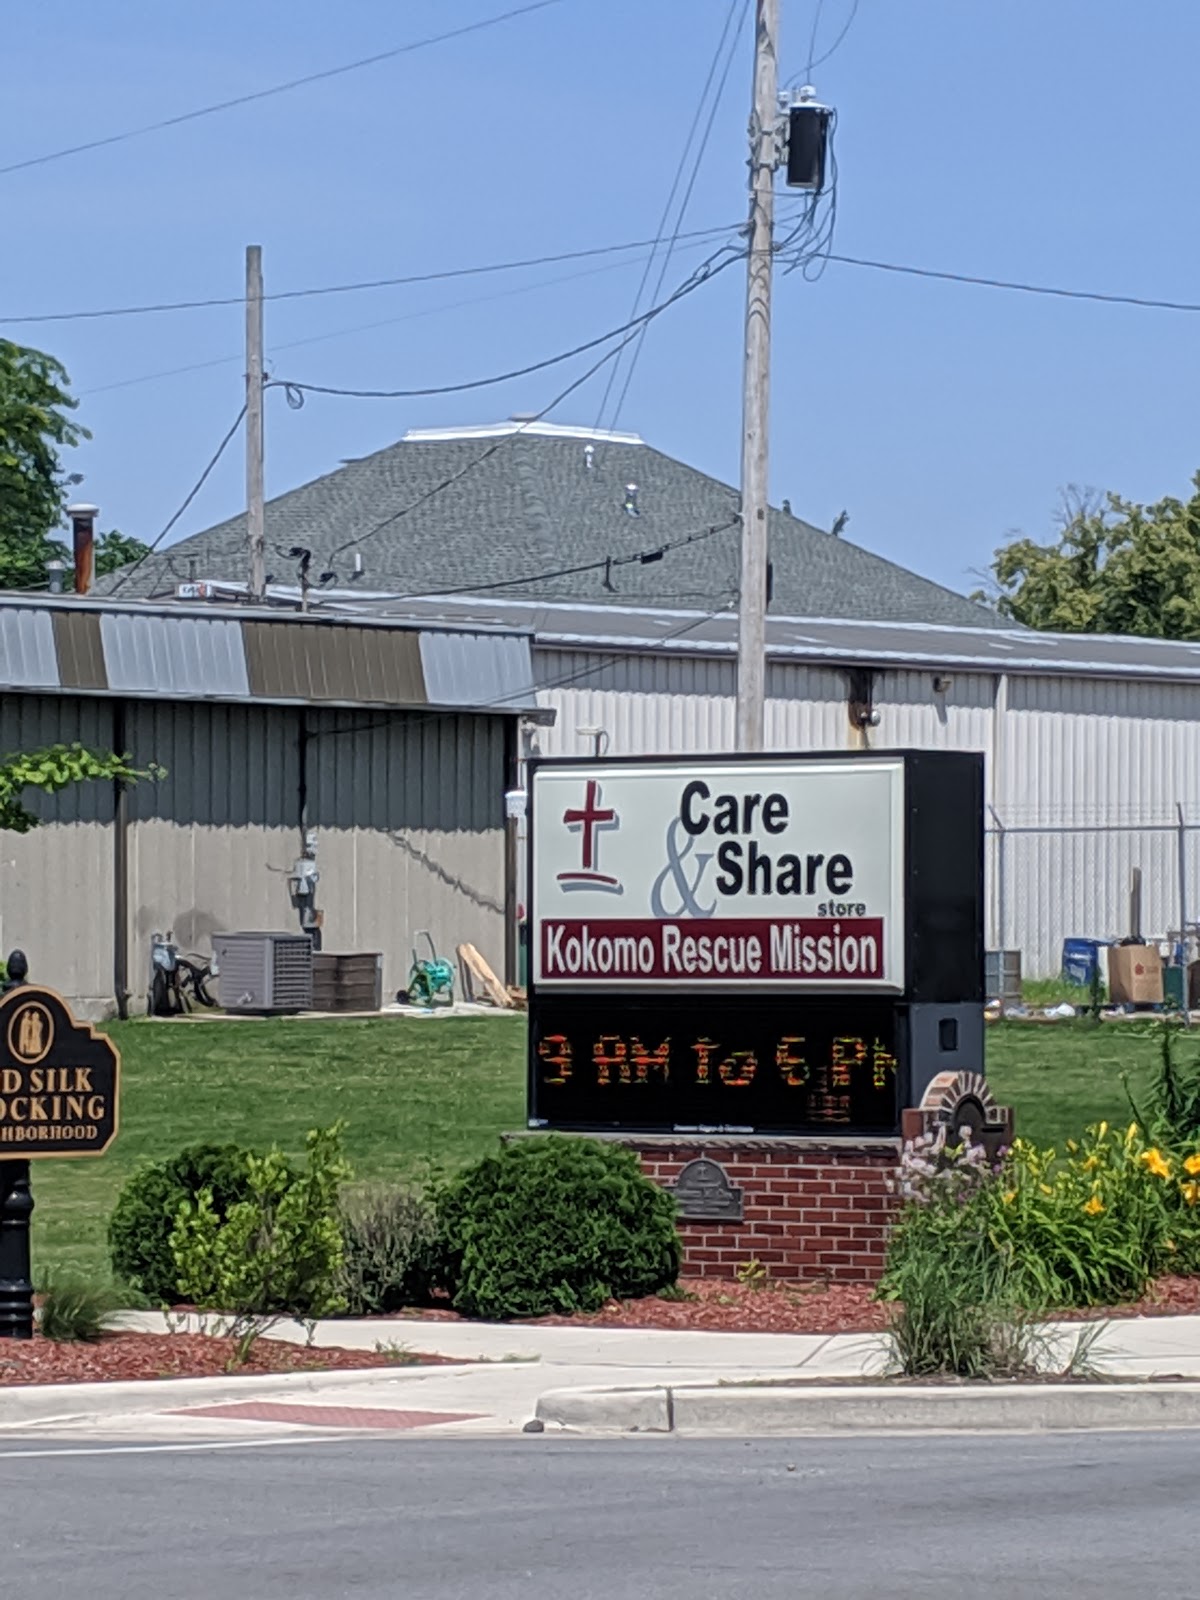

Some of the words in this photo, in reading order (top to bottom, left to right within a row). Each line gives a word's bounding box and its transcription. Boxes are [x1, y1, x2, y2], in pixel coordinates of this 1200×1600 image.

[680, 780, 789, 836] Care
[651, 816, 718, 919] &
[716, 841, 853, 896] Share
[818, 900, 866, 917] store
[547, 924, 655, 974] Kokomo
[662, 923, 762, 973] Rescue
[770, 922, 877, 973] Mission
[30, 1067, 94, 1094] SILK
[592, 1034, 672, 1085] AM
